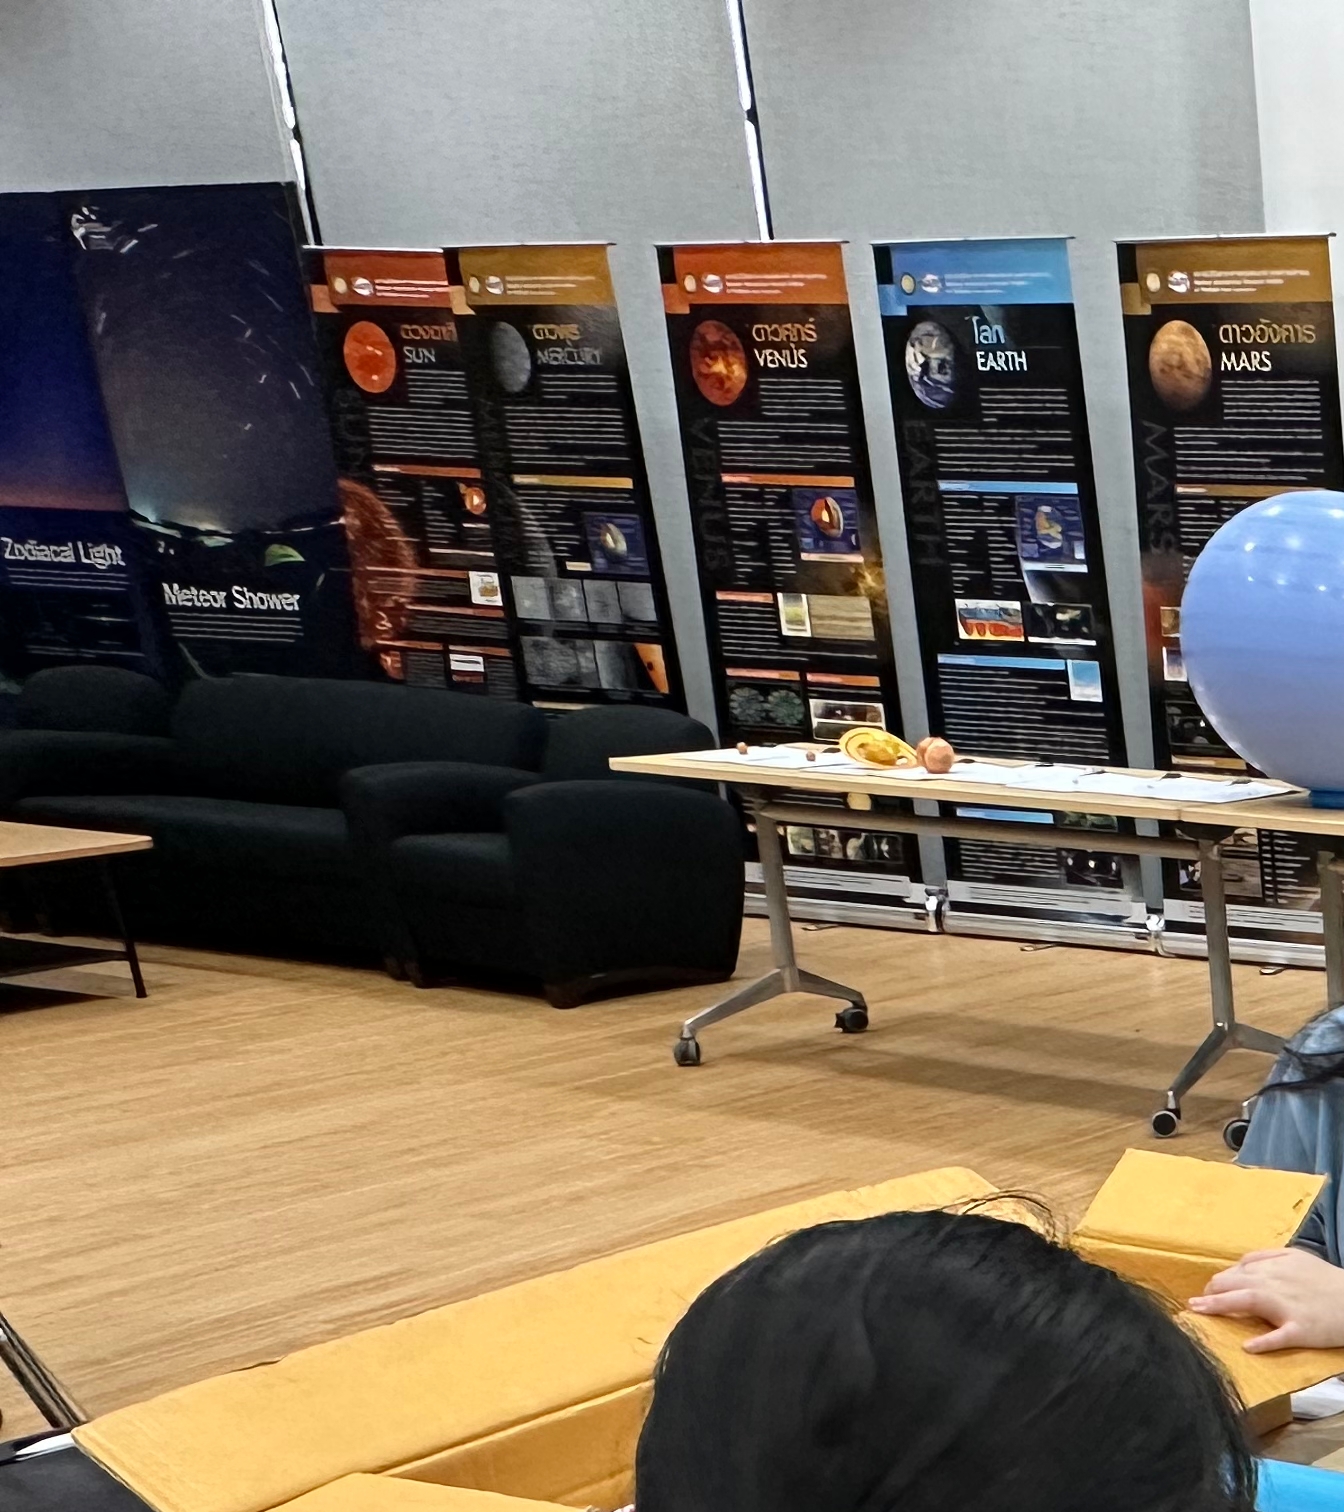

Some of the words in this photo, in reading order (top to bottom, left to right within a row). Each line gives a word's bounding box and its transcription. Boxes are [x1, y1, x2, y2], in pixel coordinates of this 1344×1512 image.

[403, 346, 436, 364] SUN
[754, 348, 808, 369] VENUS
[976, 350, 1028, 372] EARTH
[1220, 350, 1272, 372] MARS
[1141, 418, 1179, 556] MARS
[0, 537, 76, 564] Zodiacal
[78, 540, 126, 569] Light
[162, 582, 227, 608] Meteor
[232, 585, 301, 611] Shower
